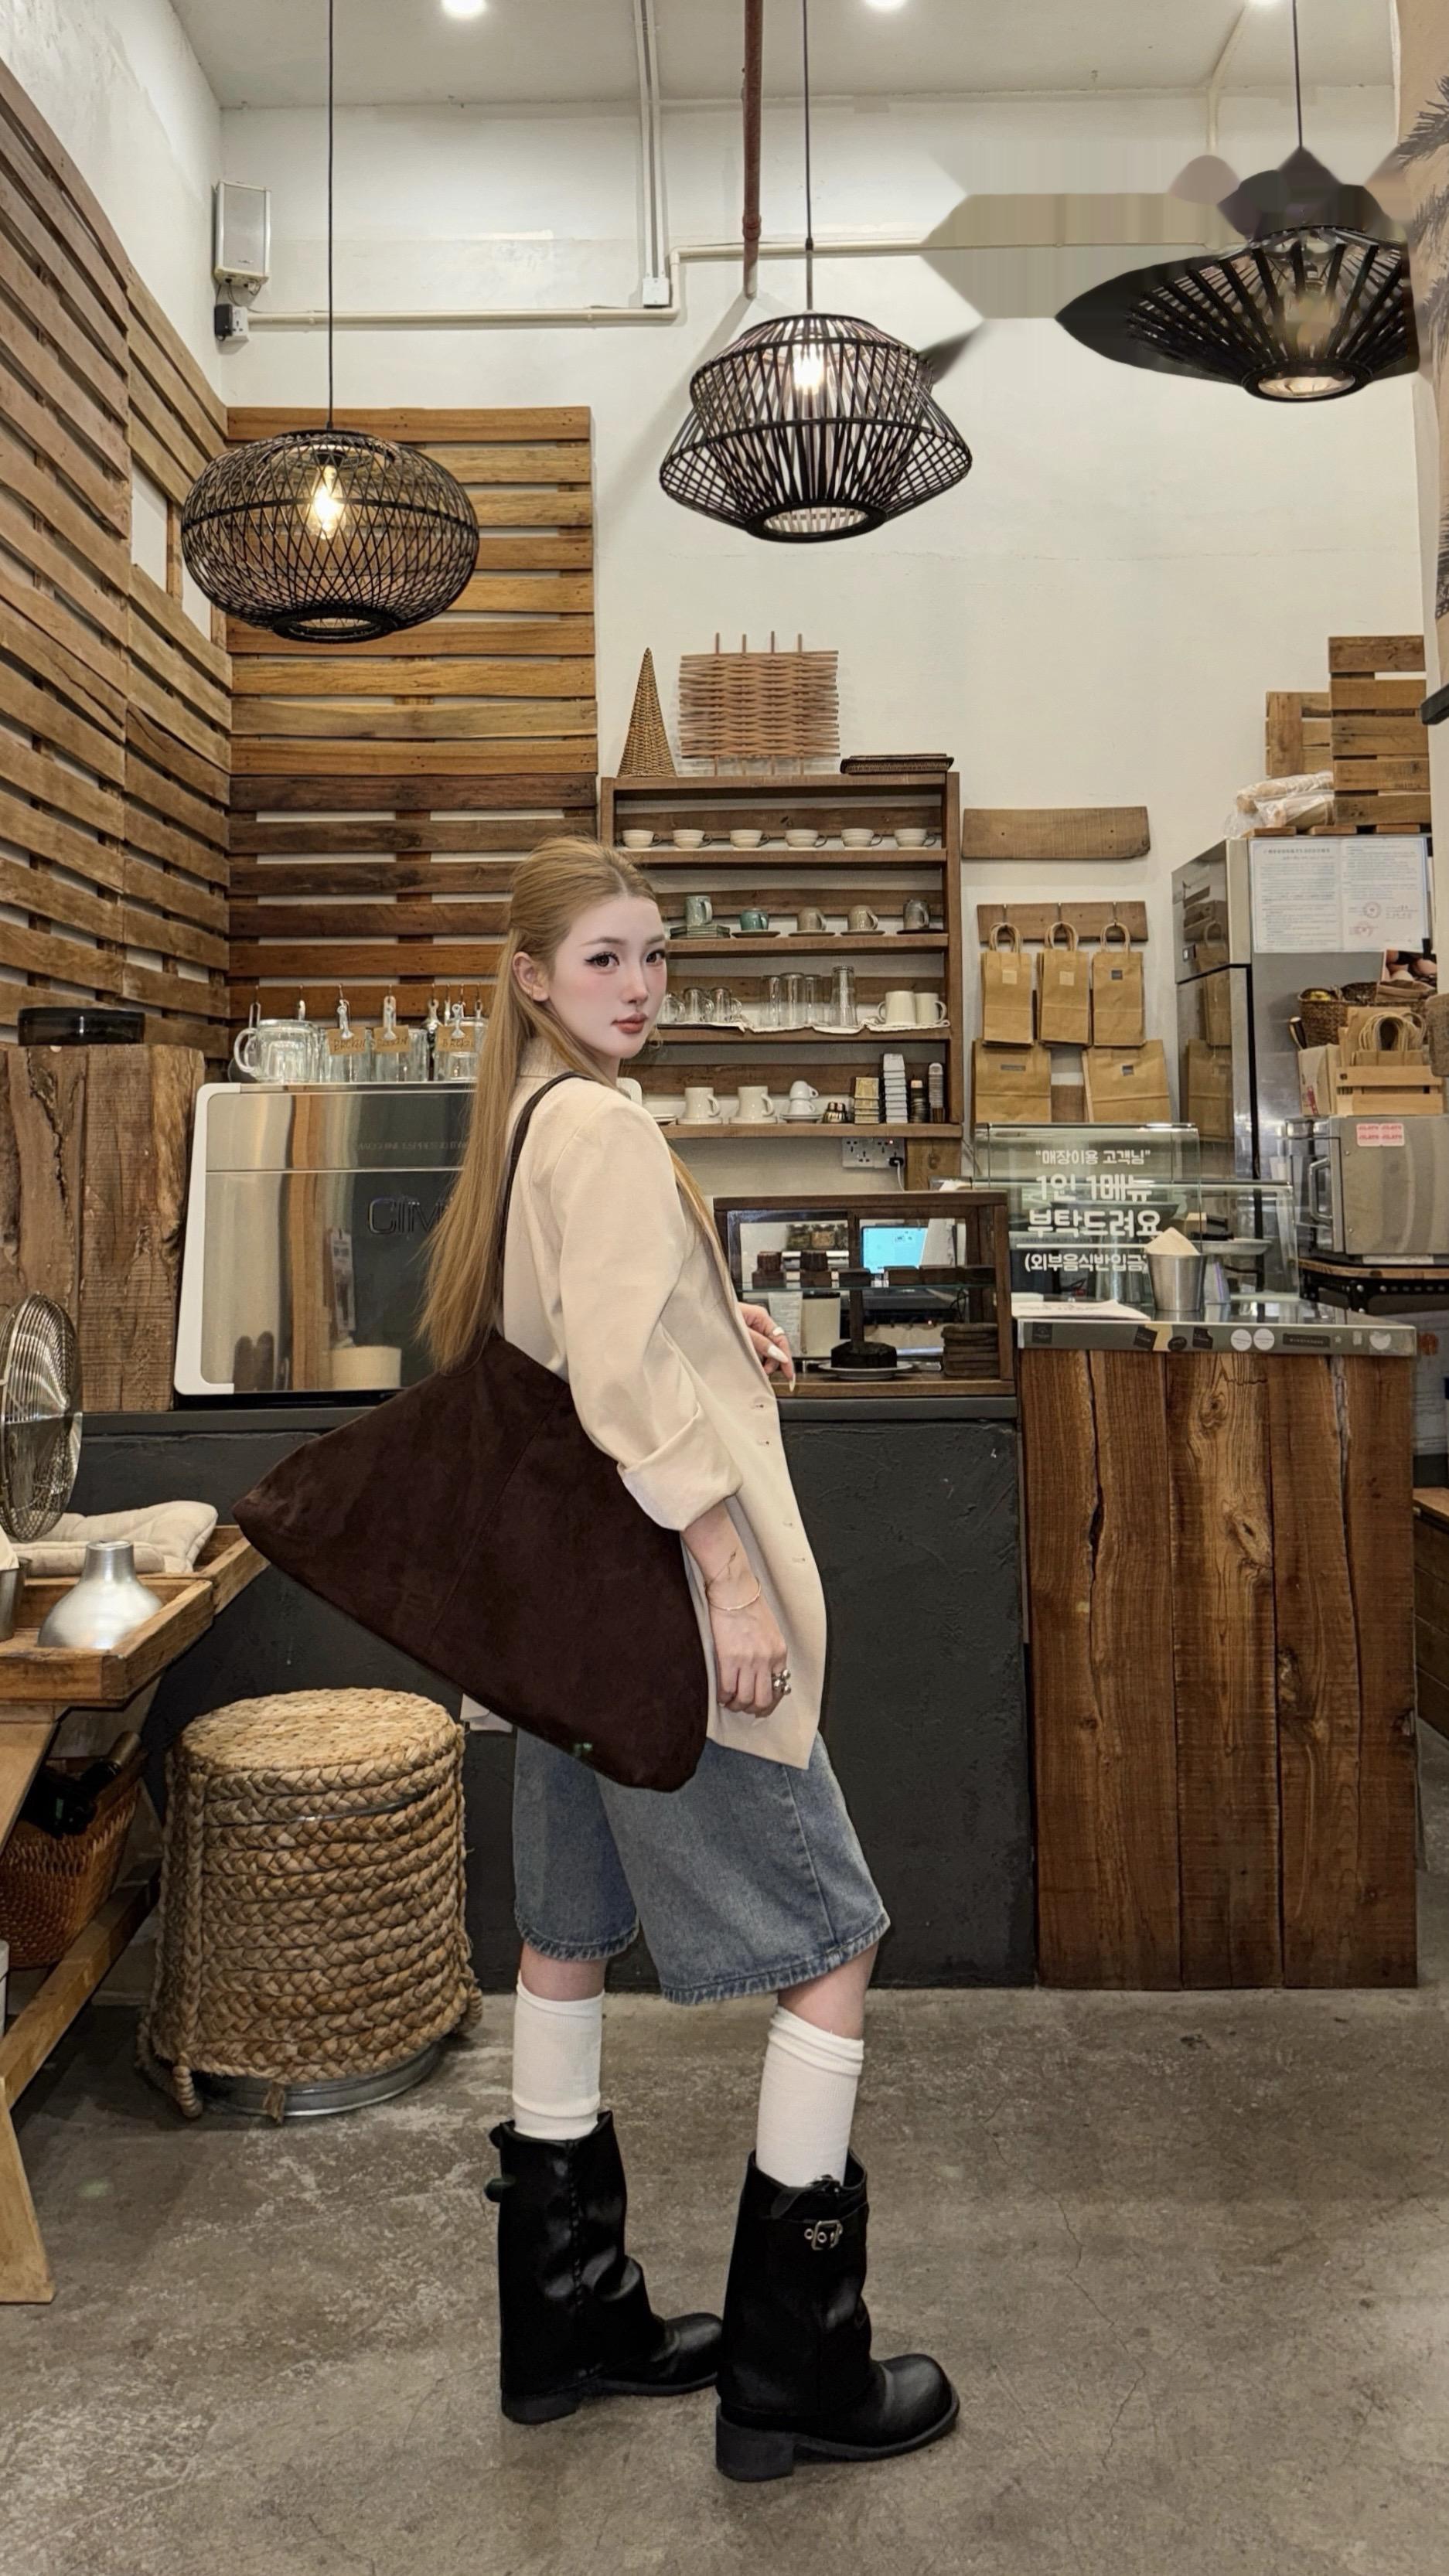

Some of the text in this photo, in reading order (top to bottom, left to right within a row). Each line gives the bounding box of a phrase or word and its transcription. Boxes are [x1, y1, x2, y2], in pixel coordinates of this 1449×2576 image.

[1035, 1150, 1151, 1165] "매장이용 고객님"
[1035, 1174, 1152, 1202] 1인 1메뉴
[1028, 1209, 1163, 1238] 부탁드려요
